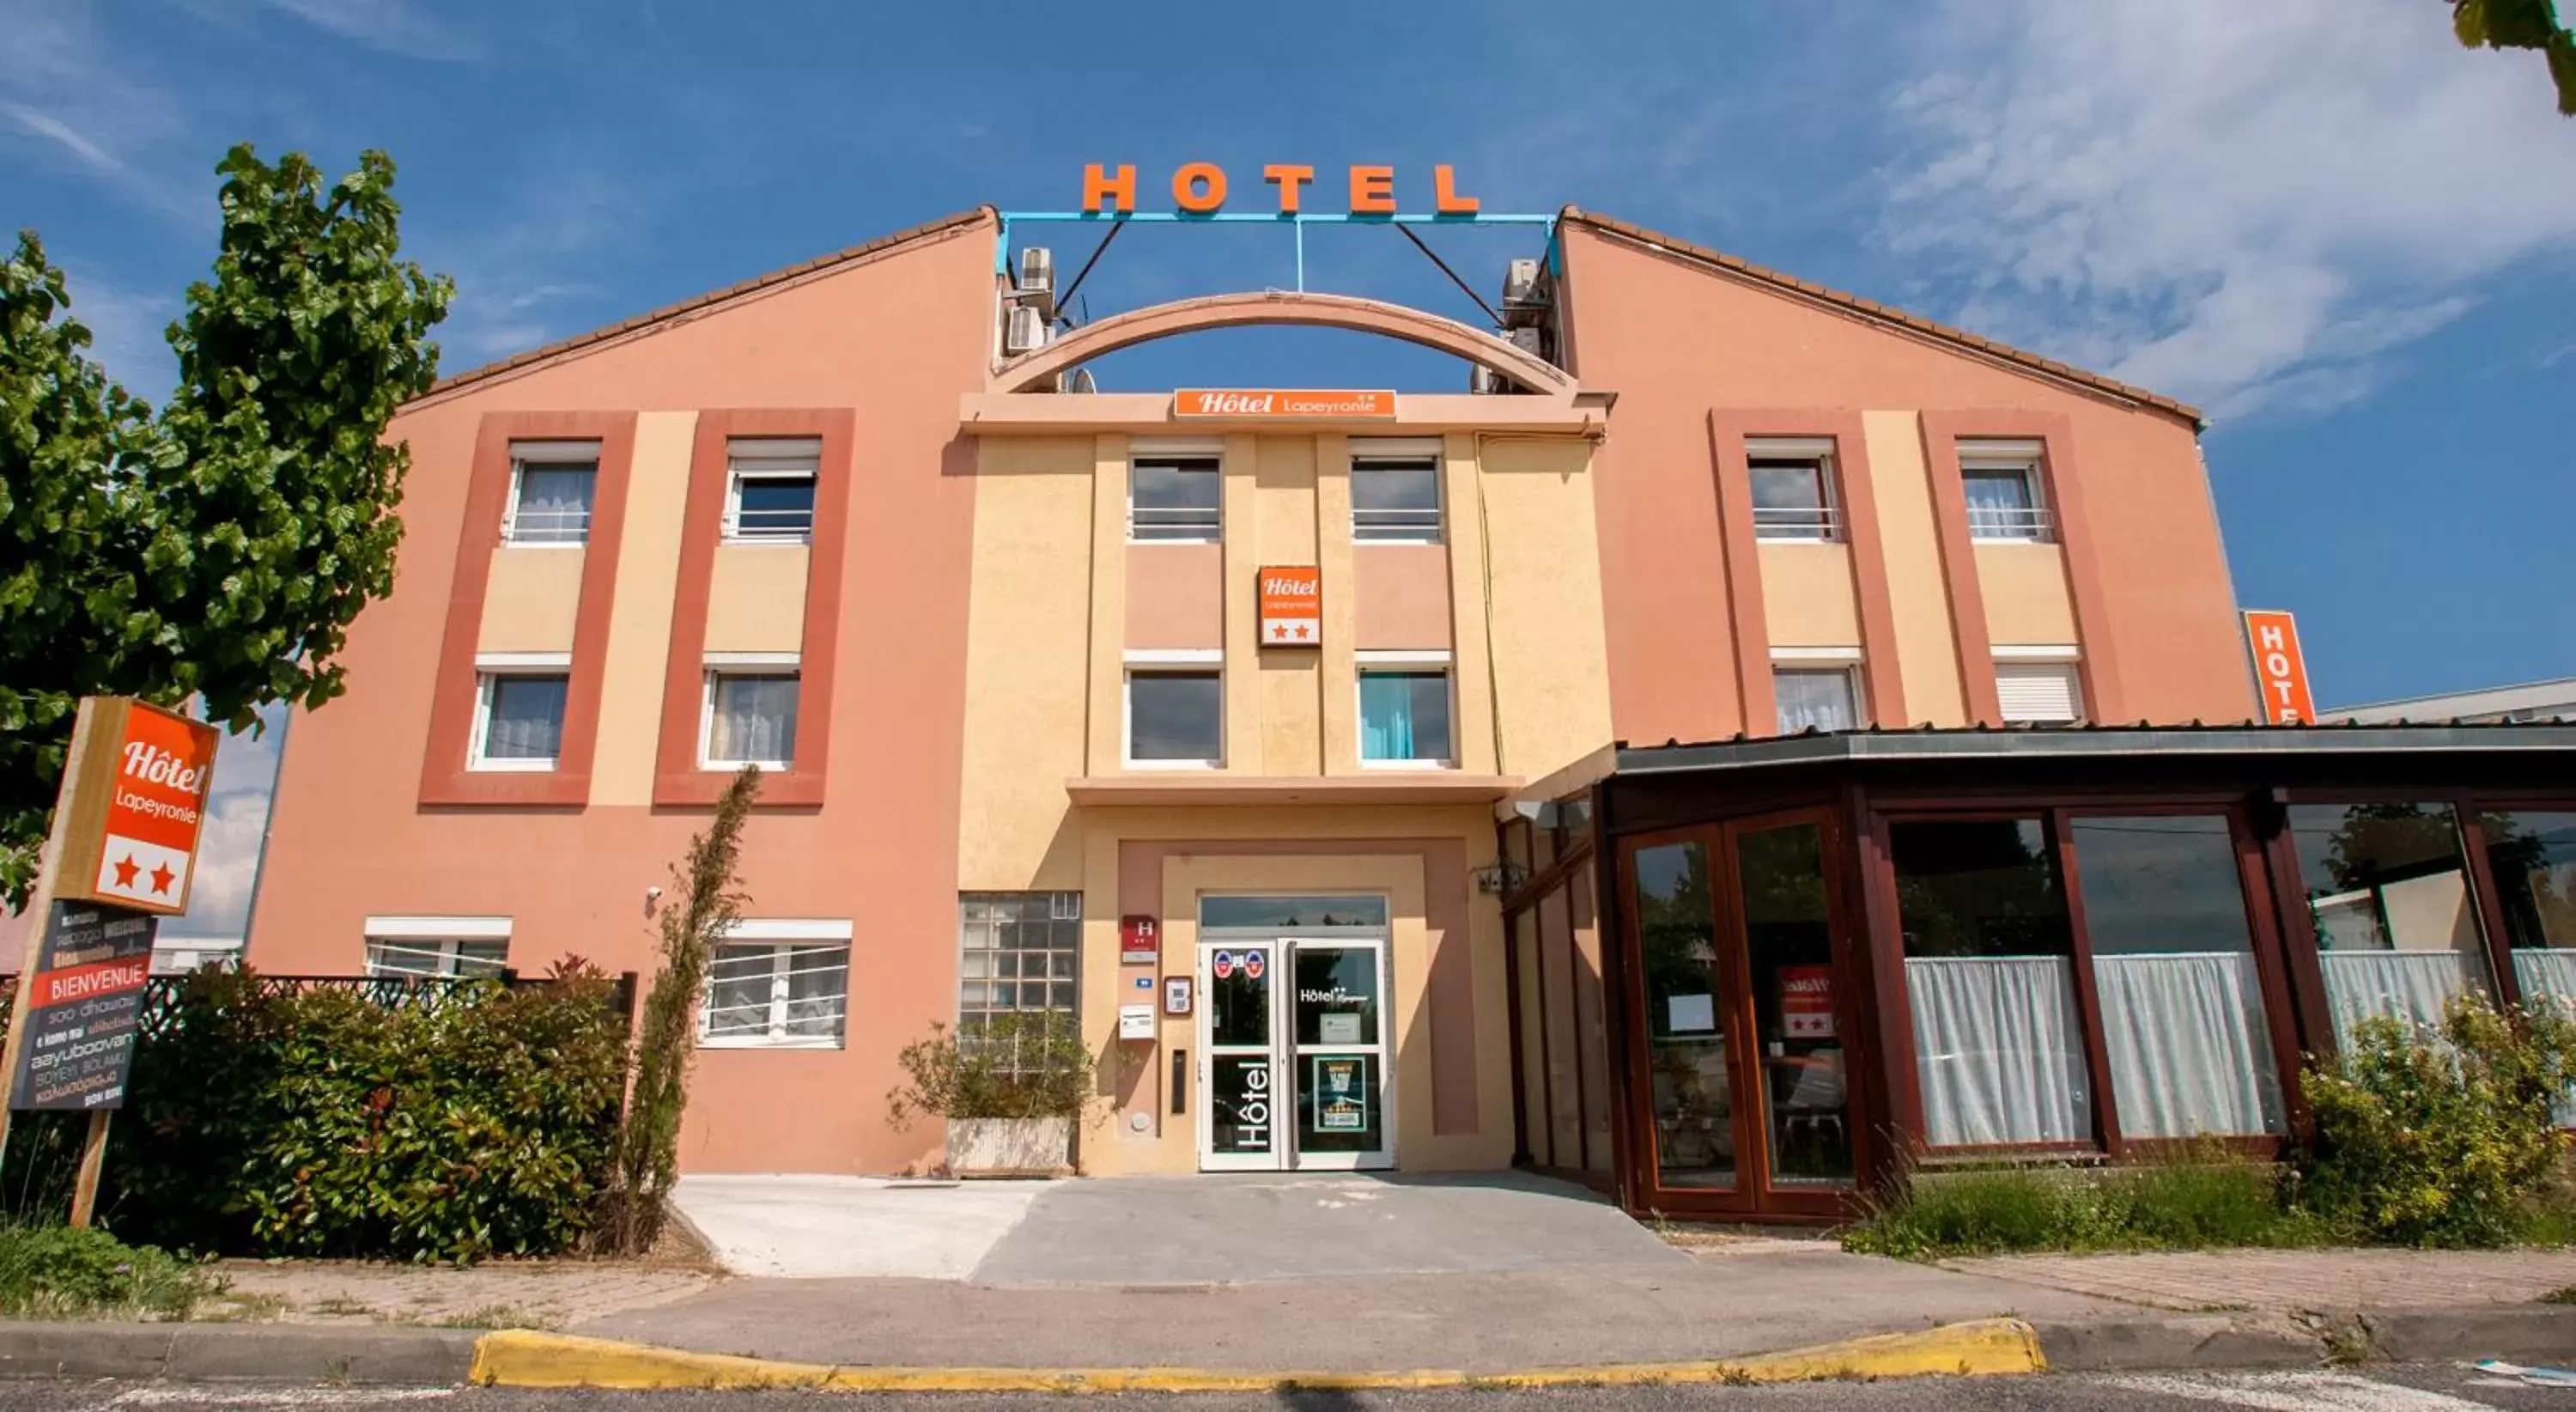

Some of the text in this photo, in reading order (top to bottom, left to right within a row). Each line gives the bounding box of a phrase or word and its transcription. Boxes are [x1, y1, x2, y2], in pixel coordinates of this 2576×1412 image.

[1082, 162, 1479, 213] HOTEL
[1199, 393, 1376, 414] Hôtel Lapeyronie
[1264, 577, 1317, 595] Hôtel
[2259, 625, 2299, 725] HOTE
[125, 741, 206, 794] Hôtel
[116, 784, 197, 824] Lapeyronie
[1138, 922, 1152, 936] H
[52, 964, 143, 1001] BIENVENUE
[1300, 989, 1334, 1002] Hôtel
[1237, 1062, 1268, 1147] Hôtel
